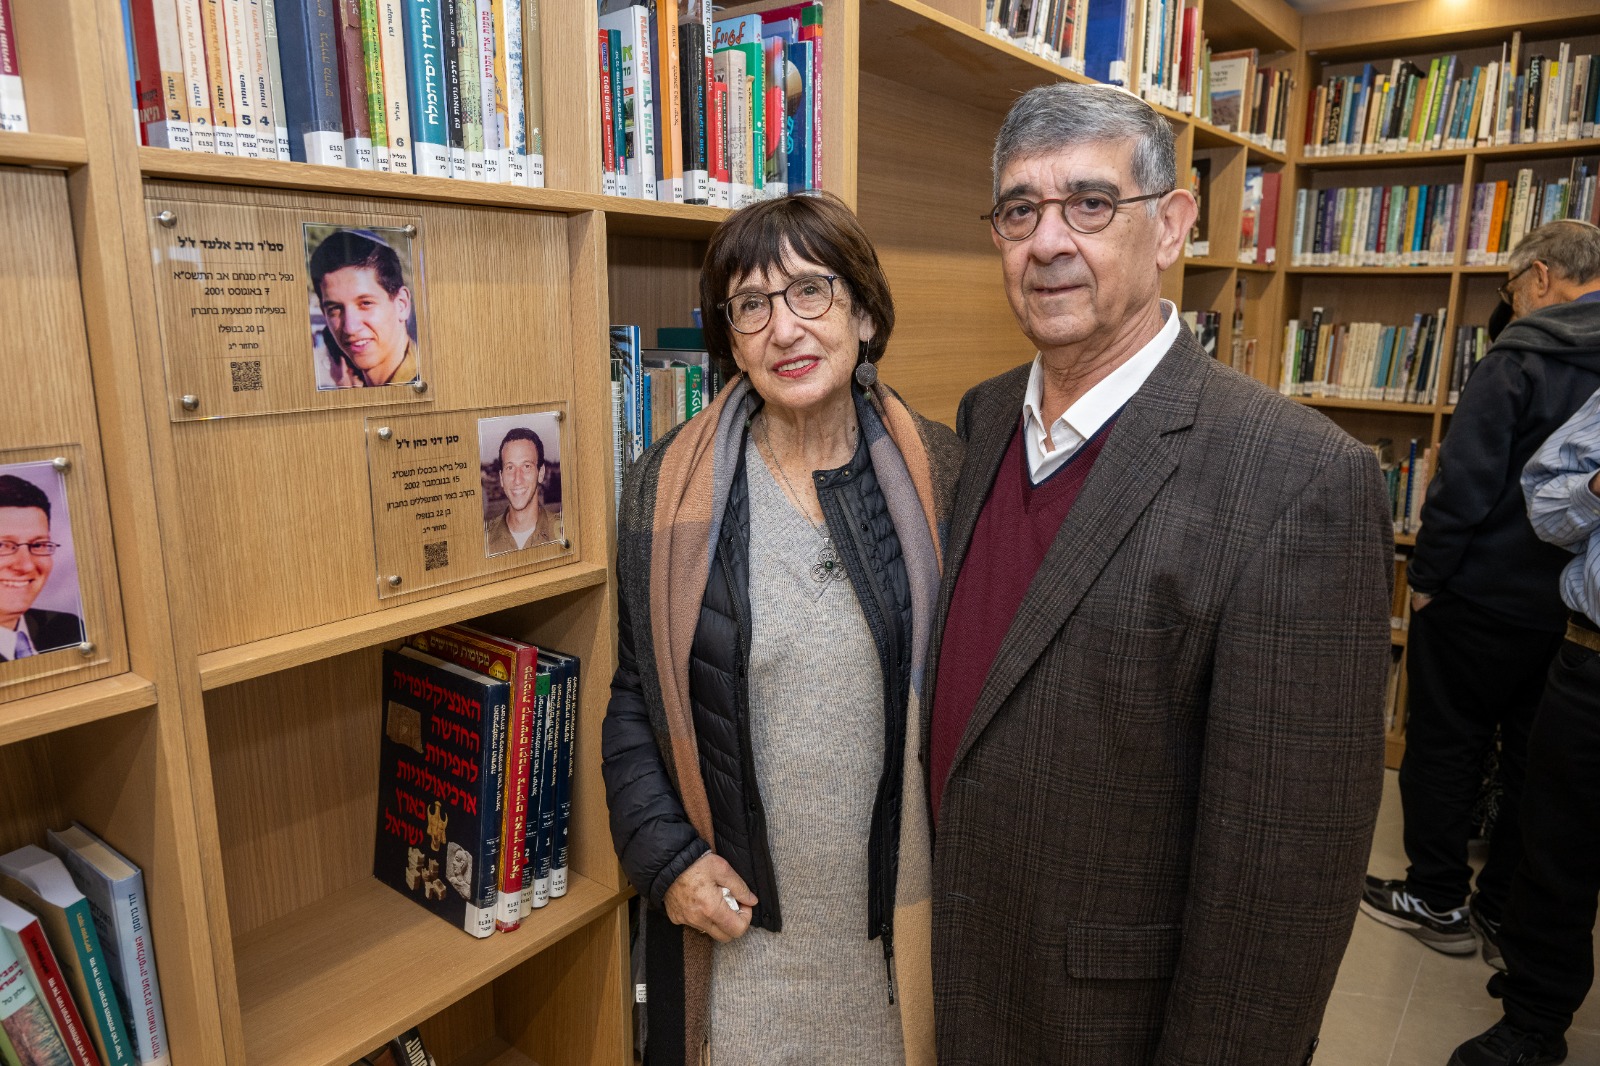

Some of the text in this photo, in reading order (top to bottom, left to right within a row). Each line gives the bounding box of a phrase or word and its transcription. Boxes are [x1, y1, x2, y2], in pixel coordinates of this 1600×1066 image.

[421, 8, 436, 48] הירדן
[190, 52, 198, 78] ישראל
[240, 75, 249, 106] השומרון
[259, 77, 268, 108] השומרון
[171, 110, 180, 120] 3
[242, 115, 251, 125] 5
[260, 116, 269, 126] 4
[396, 138, 404, 147] 6
[178, 236, 284, 251] סמ"ר נדב אלעד ז"ל
[279, 272, 294, 281] נפל
[191, 307, 219, 317] בחברון
[218, 324, 243, 333] בנופלו
[257, 325, 264, 334] בן
[396, 435, 459, 449] סגן דני כהן ז"ל
[404, 482, 419, 490] 2002
[422, 477, 451, 486] בנובמבר
[387, 500, 409, 511] בחברון
[416, 512, 435, 520] בנופלו
[445, 509, 451, 518] בן
[393, 669, 481, 723] האנציקלופדיה
[432, 714, 480, 753] החדשה
[425, 742, 478, 782] לחפירות
[509, 666, 534, 879] מקומות קדושים וקברי צדיקים בארץ ישראל
[396, 760, 476, 816] ארכיאולוגיות
[396, 787, 426, 820] בארץ
[385, 807, 424, 845] ישראל
[546, 838, 550, 846] 1
[491, 865, 495, 874] 3
[129, 893, 161, 1059] דוד גרוסמן האוכלוסייה הערבית והמאחז היהודי
[13, 985, 26, 1000] אלון
[115, 1041, 123, 1060] ישראל
